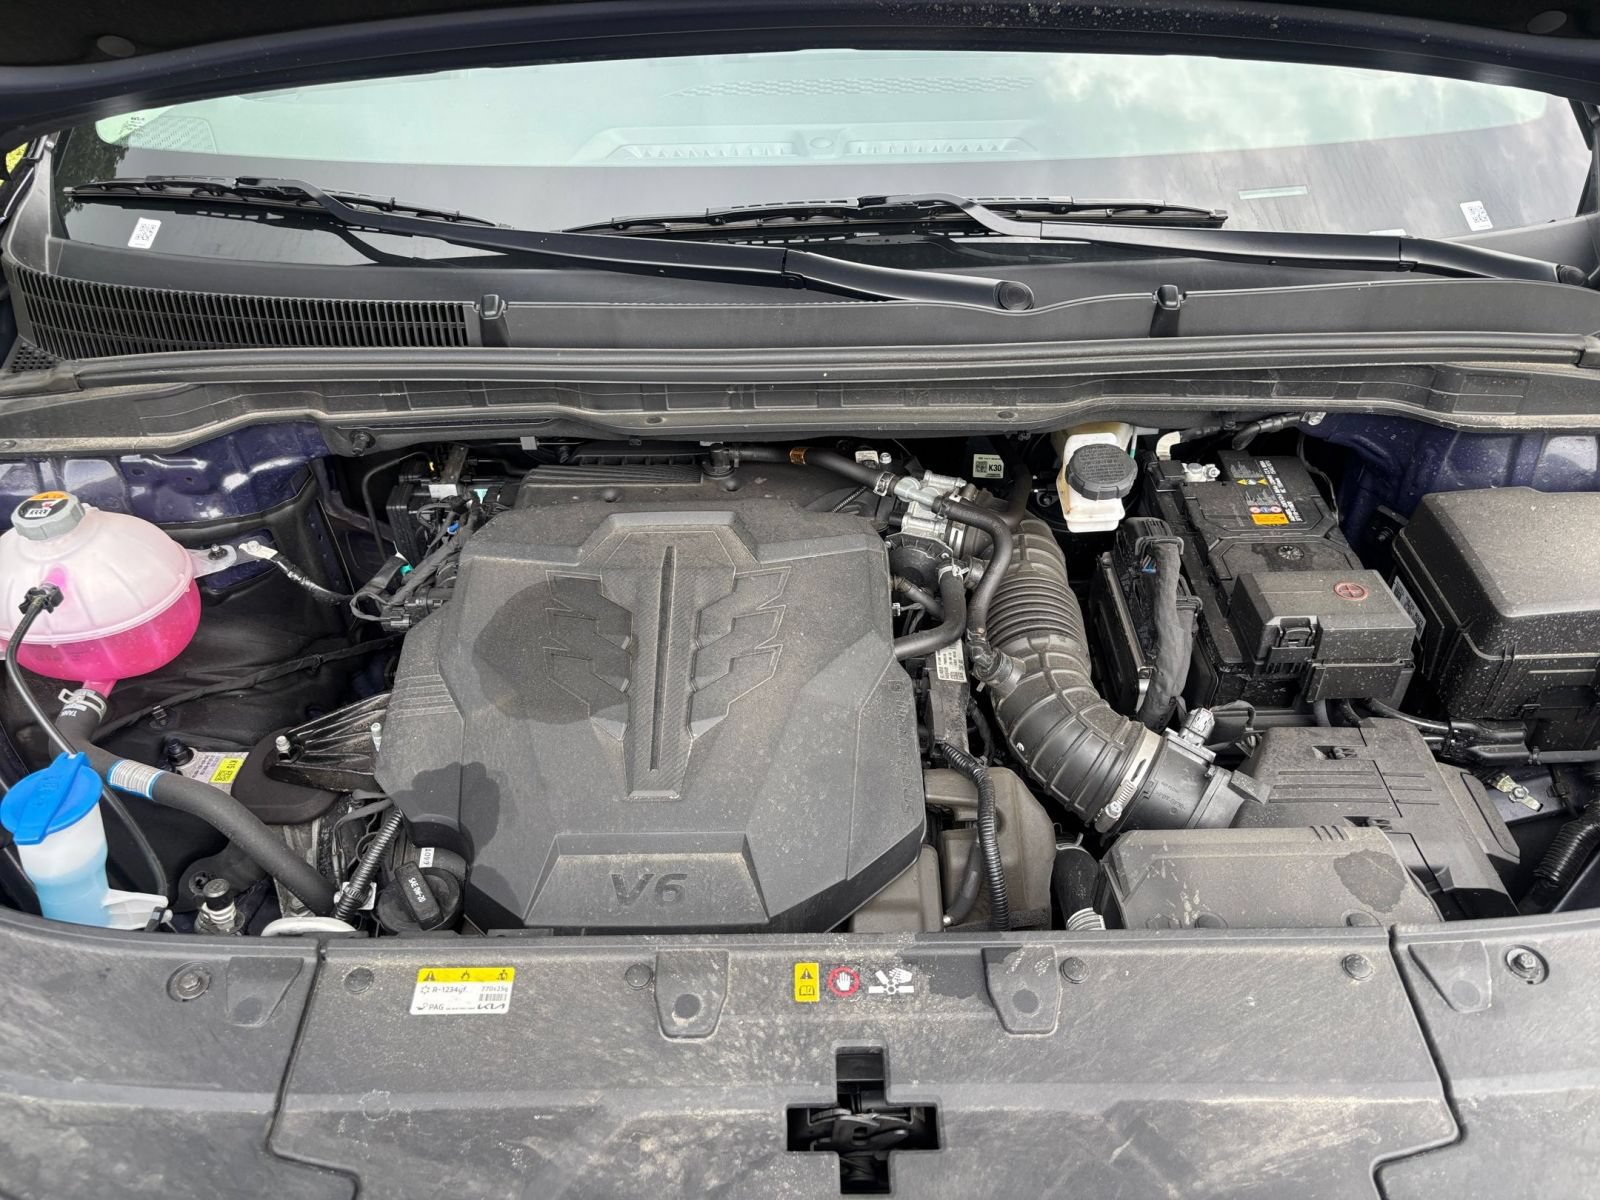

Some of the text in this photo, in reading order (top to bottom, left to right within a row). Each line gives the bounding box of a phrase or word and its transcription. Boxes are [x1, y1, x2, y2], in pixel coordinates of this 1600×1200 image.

[988, 463, 1002, 472] K30
[408, 877, 419, 888] SAE
[611, 873, 688, 907] V6
